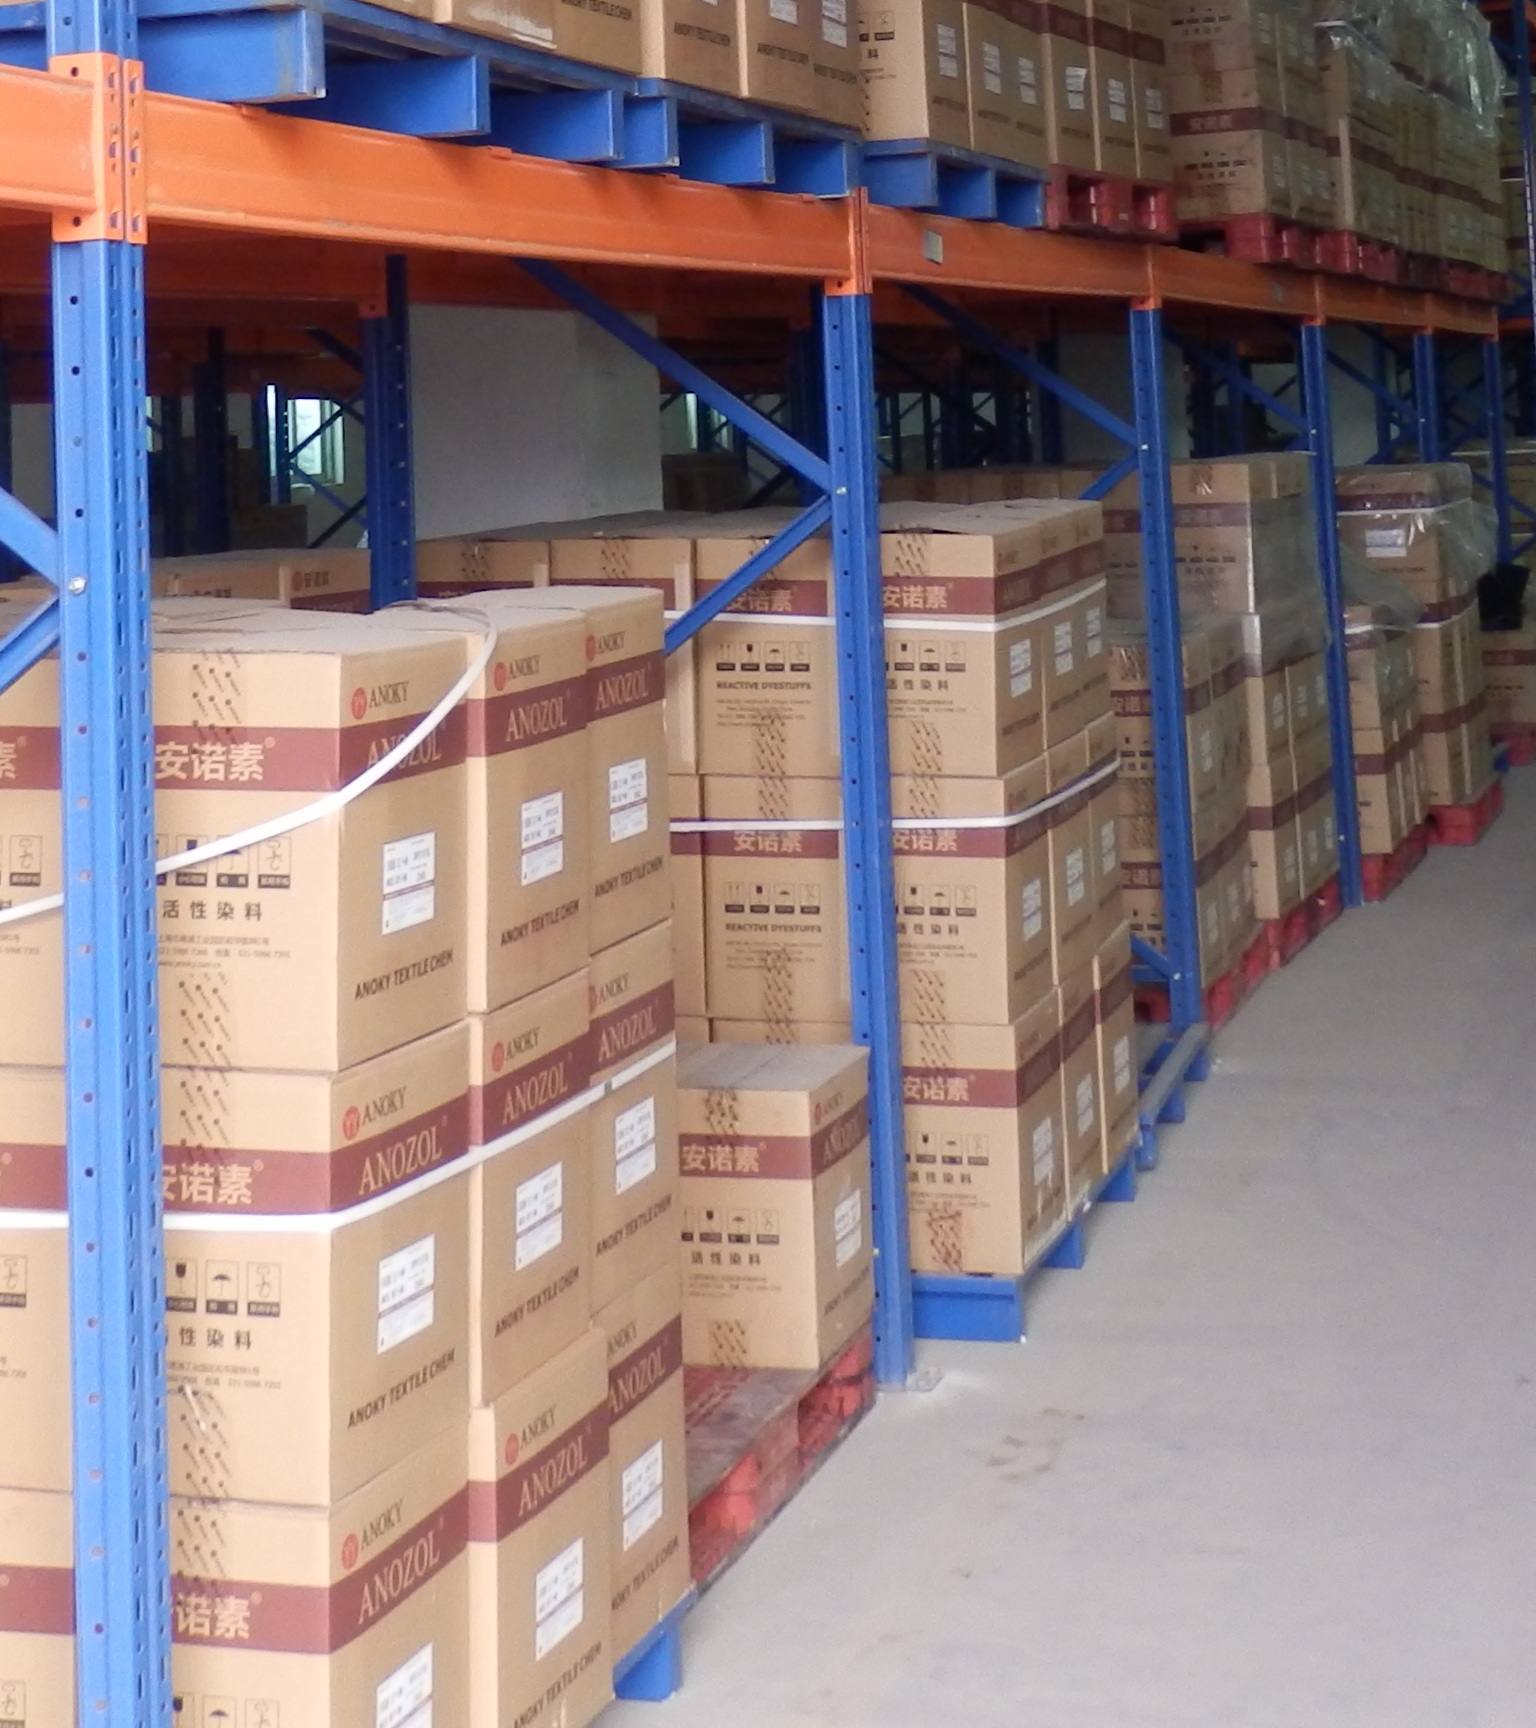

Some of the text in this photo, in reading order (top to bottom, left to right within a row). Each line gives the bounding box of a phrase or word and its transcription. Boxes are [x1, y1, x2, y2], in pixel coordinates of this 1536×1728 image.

[883, 585, 948, 609] 安诺素
[508, 655, 541, 680] ANOKY
[369, 681, 410, 709] ANOKY
[595, 673, 651, 713] ANOZOL
[506, 702, 568, 743] ANOZOL
[156, 742, 265, 783] 安诺素
[734, 828, 803, 853] 安诺素
[162, 899, 263, 922] 活性染料
[500, 898, 580, 947] ANOKY TEXTILE CHEM
[354, 949, 454, 1001] ANOKY TEXTILE CHEM
[506, 1026, 541, 1063] ANOKY
[599, 1015, 657, 1062] ANOZOL
[361, 1087, 407, 1125] ANOKY
[503, 1062, 568, 1123] ANOZOL
[902, 1075, 969, 1103] 安诺素
[358, 1129, 442, 1196] ANOZOL
[681, 1143, 761, 1173] 安诺素
[162, 1162, 254, 1206] 安诺素
[494, 1267, 579, 1337] ANOKY TEXTILE CHEM
[178, 1326, 252, 1350] 性染料
[347, 1348, 455, 1429] ANOKY TEXTILE CHEM
[520, 1405, 557, 1450] ANOKY
[519, 1436, 589, 1516] ANOZOL
[360, 1497, 405, 1549] ANOKY
[358, 1533, 442, 1626] ANOZOL
[172, 1593, 252, 1639] 诺素
[574, 1640, 603, 1678] CHEM
